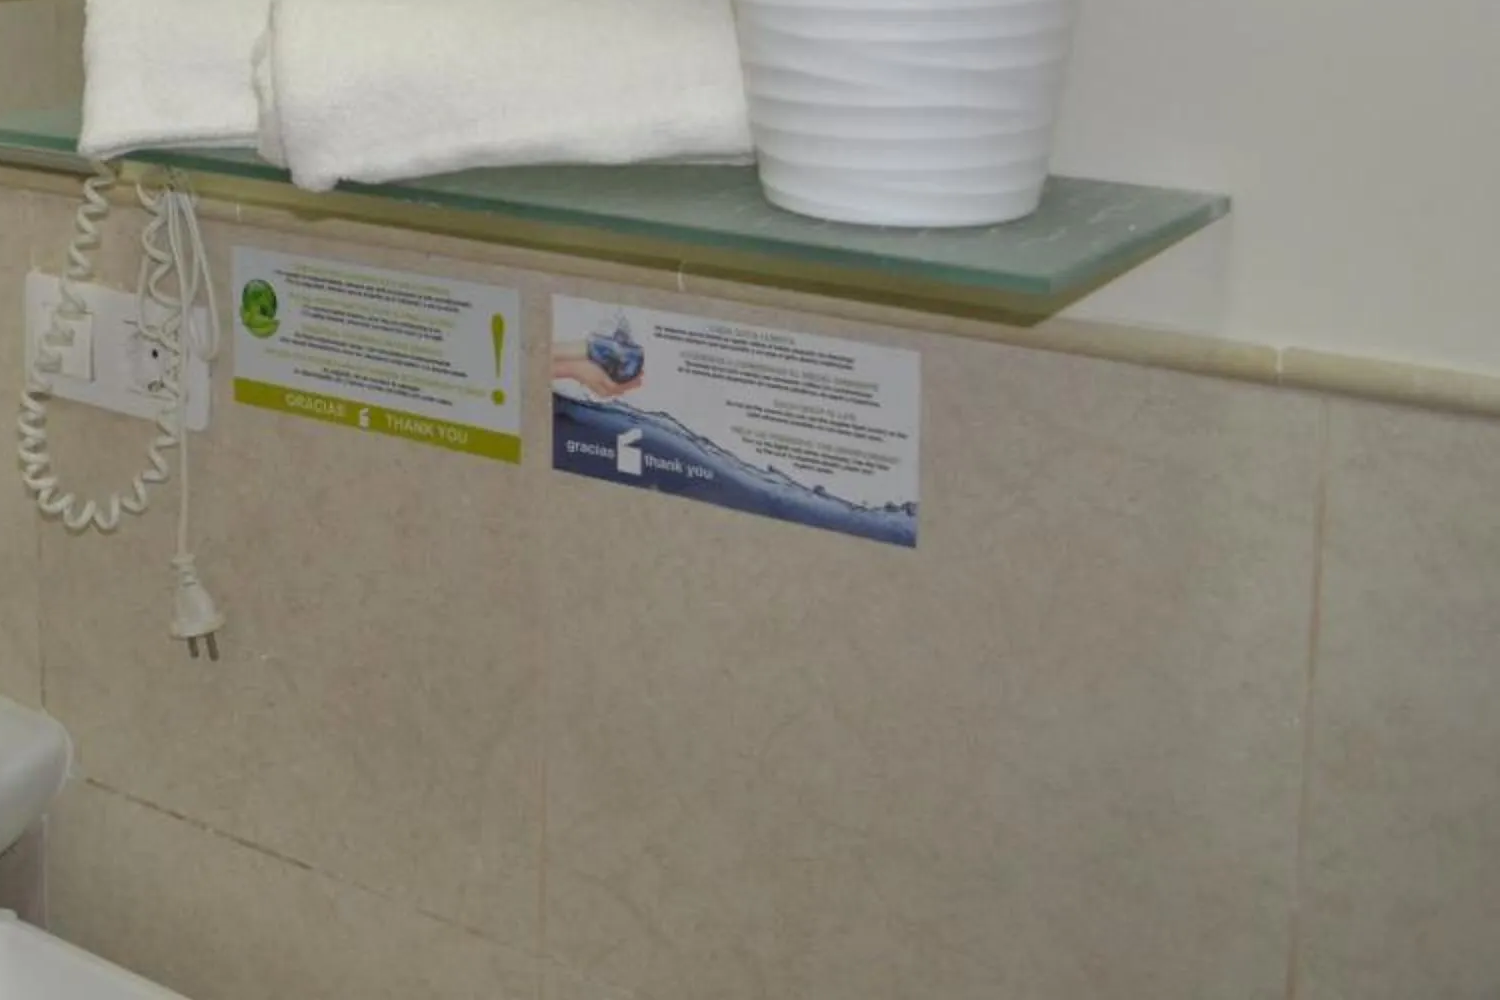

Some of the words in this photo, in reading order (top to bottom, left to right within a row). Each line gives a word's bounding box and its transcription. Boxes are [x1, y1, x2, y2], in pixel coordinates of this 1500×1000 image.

[285, 393, 346, 417] GRACIAS
[384, 413, 433, 437] THANK
[436, 426, 468, 445] YOU
[566, 439, 615, 459] gracias
[644, 454, 683, 473] thank
[686, 465, 713, 479] you
